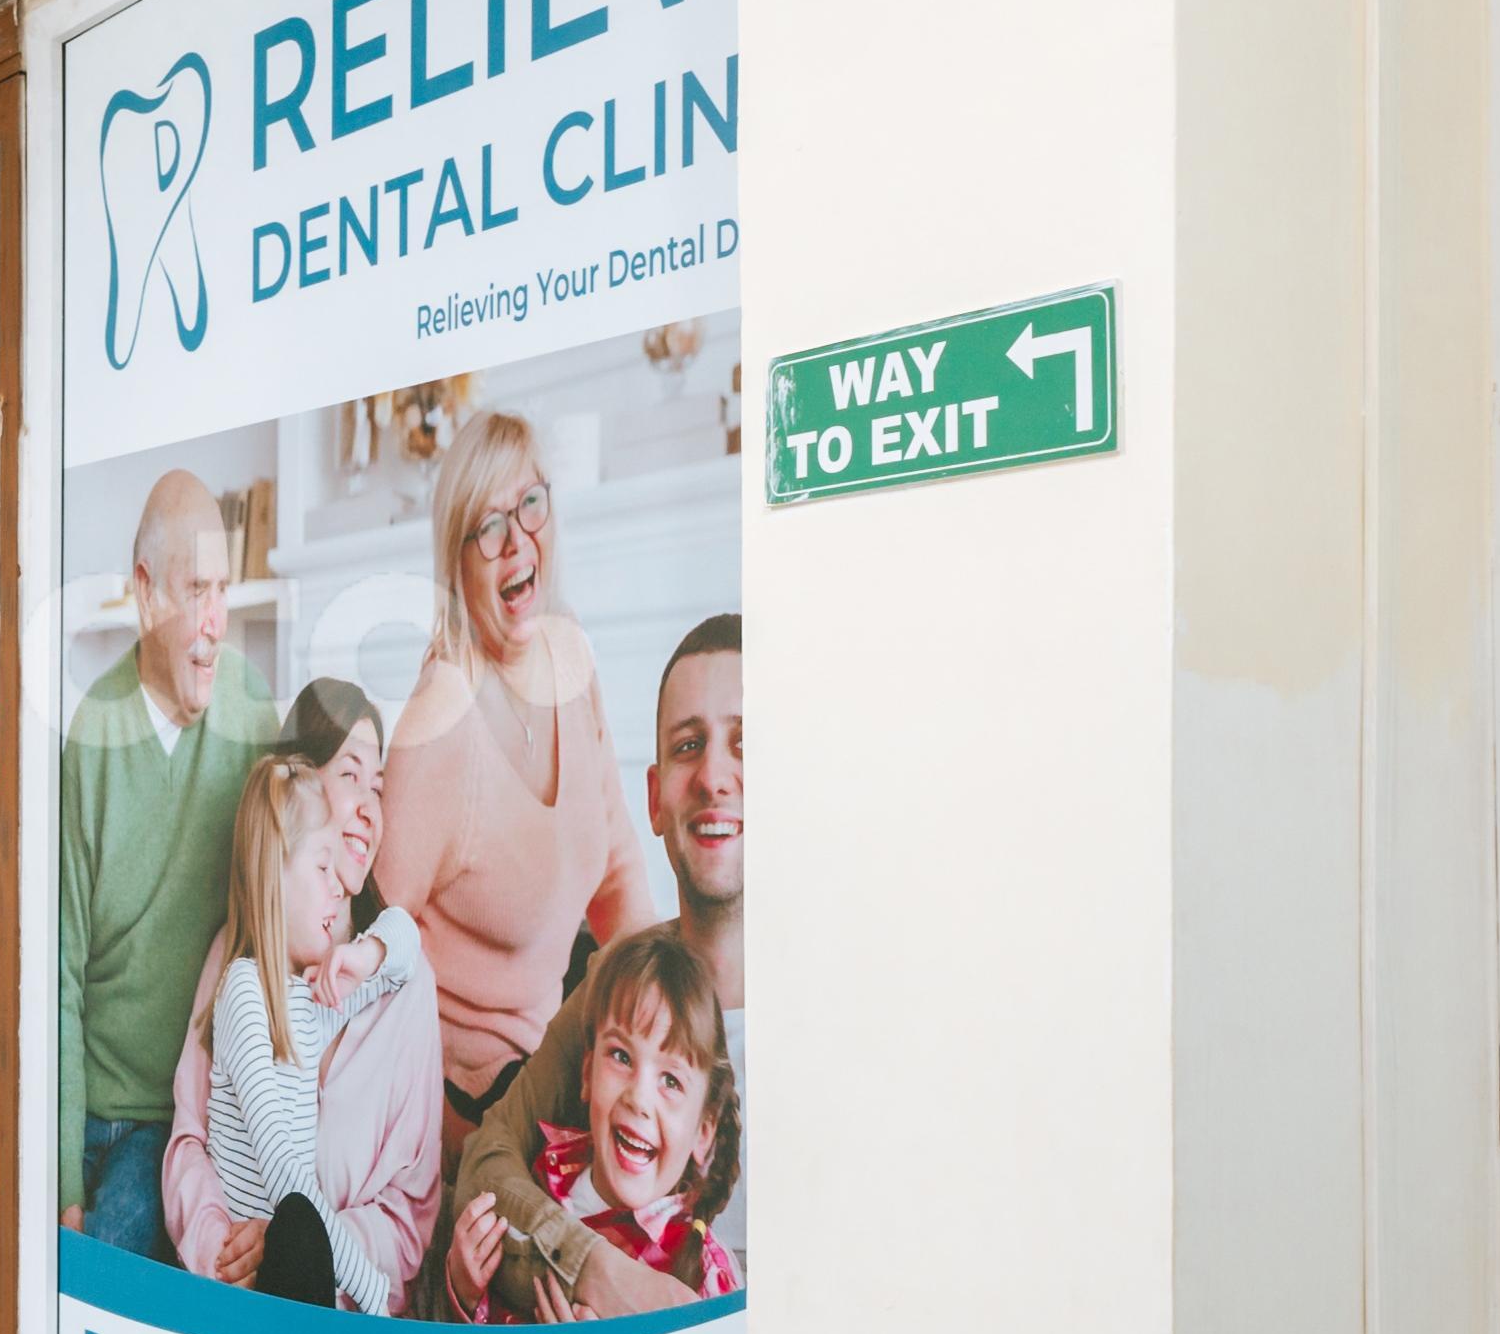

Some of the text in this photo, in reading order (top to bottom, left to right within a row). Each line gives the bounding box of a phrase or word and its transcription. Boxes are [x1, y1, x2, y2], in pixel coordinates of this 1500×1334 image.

[251, 53, 739, 304] DENTAL CLIN
[416, 283, 529, 340] Relieving
[536, 264, 600, 306] Your
[607, 223, 705, 289] Dental
[828, 341, 948, 410] WAY
[786, 396, 999, 479] TO EXIT
